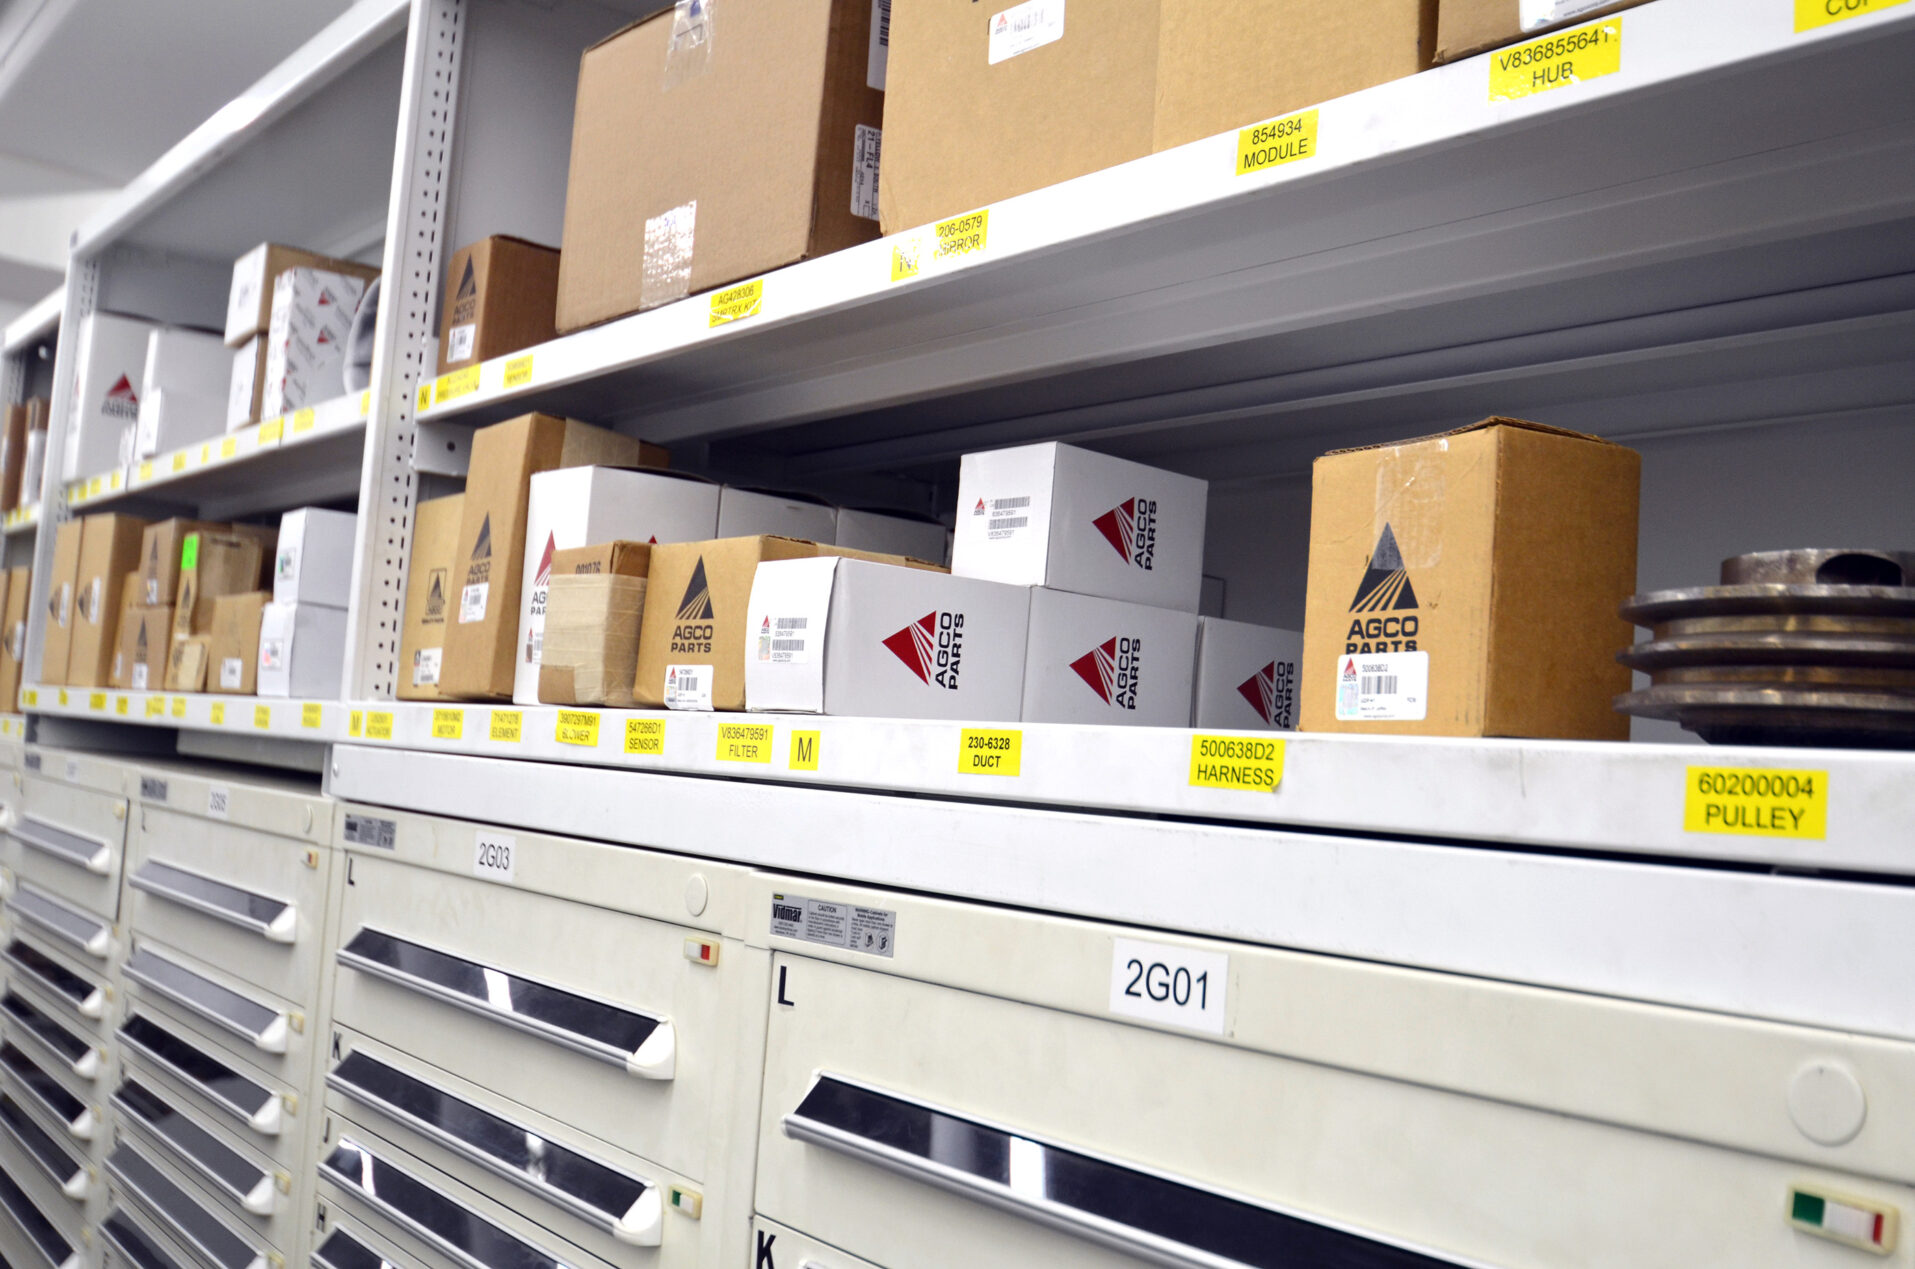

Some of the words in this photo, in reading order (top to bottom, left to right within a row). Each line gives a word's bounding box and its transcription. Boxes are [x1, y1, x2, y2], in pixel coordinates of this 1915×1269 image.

[1533, 61, 1573, 87] HUB
[1252, 118, 1302, 145] 854934
[1244, 138, 1308, 169] MODULE
[939, 215, 983, 238] 206-0579
[1135, 498, 1147, 569] AGCO
[1144, 500, 1157, 571] PARTS
[532, 590, 546, 605] AG
[672, 625, 713, 641] AGCO
[1347, 616, 1419, 640] AGCO
[671, 642, 712, 653] PARTS
[935, 612, 952, 688] AGCO
[948, 613, 964, 690] PARTS
[1345, 640, 1418, 655] PARTS
[1116, 637, 1130, 709] AGCO
[1127, 638, 1141, 710] PARTS
[1274, 661, 1286, 727] AGCO
[1283, 662, 1294, 728] PARTS
[562, 728, 590, 742] BLOWER
[628, 738, 659, 751] SENSOR
[968, 736, 1010, 750] 230-6328
[728, 744, 758, 759] FILTER
[797, 736, 812, 763] M
[973, 754, 1001, 768] DUCT
[1200, 739, 1275, 761] 500638D2
[1197, 763, 1274, 786] HARNESS
[1698, 772, 1814, 799] 60200004
[1705, 803, 1806, 831] PULLEY
[478, 842, 510, 871] 2G03
[773, 903, 802, 923] Vidmar
[817, 904, 837, 913] CAUTION
[778, 965, 795, 1007] L
[1124, 958, 1208, 1011] 2G01
[331, 1031, 342, 1061] K
[315, 1201, 328, 1234] H
[756, 1229, 777, 1269] K
